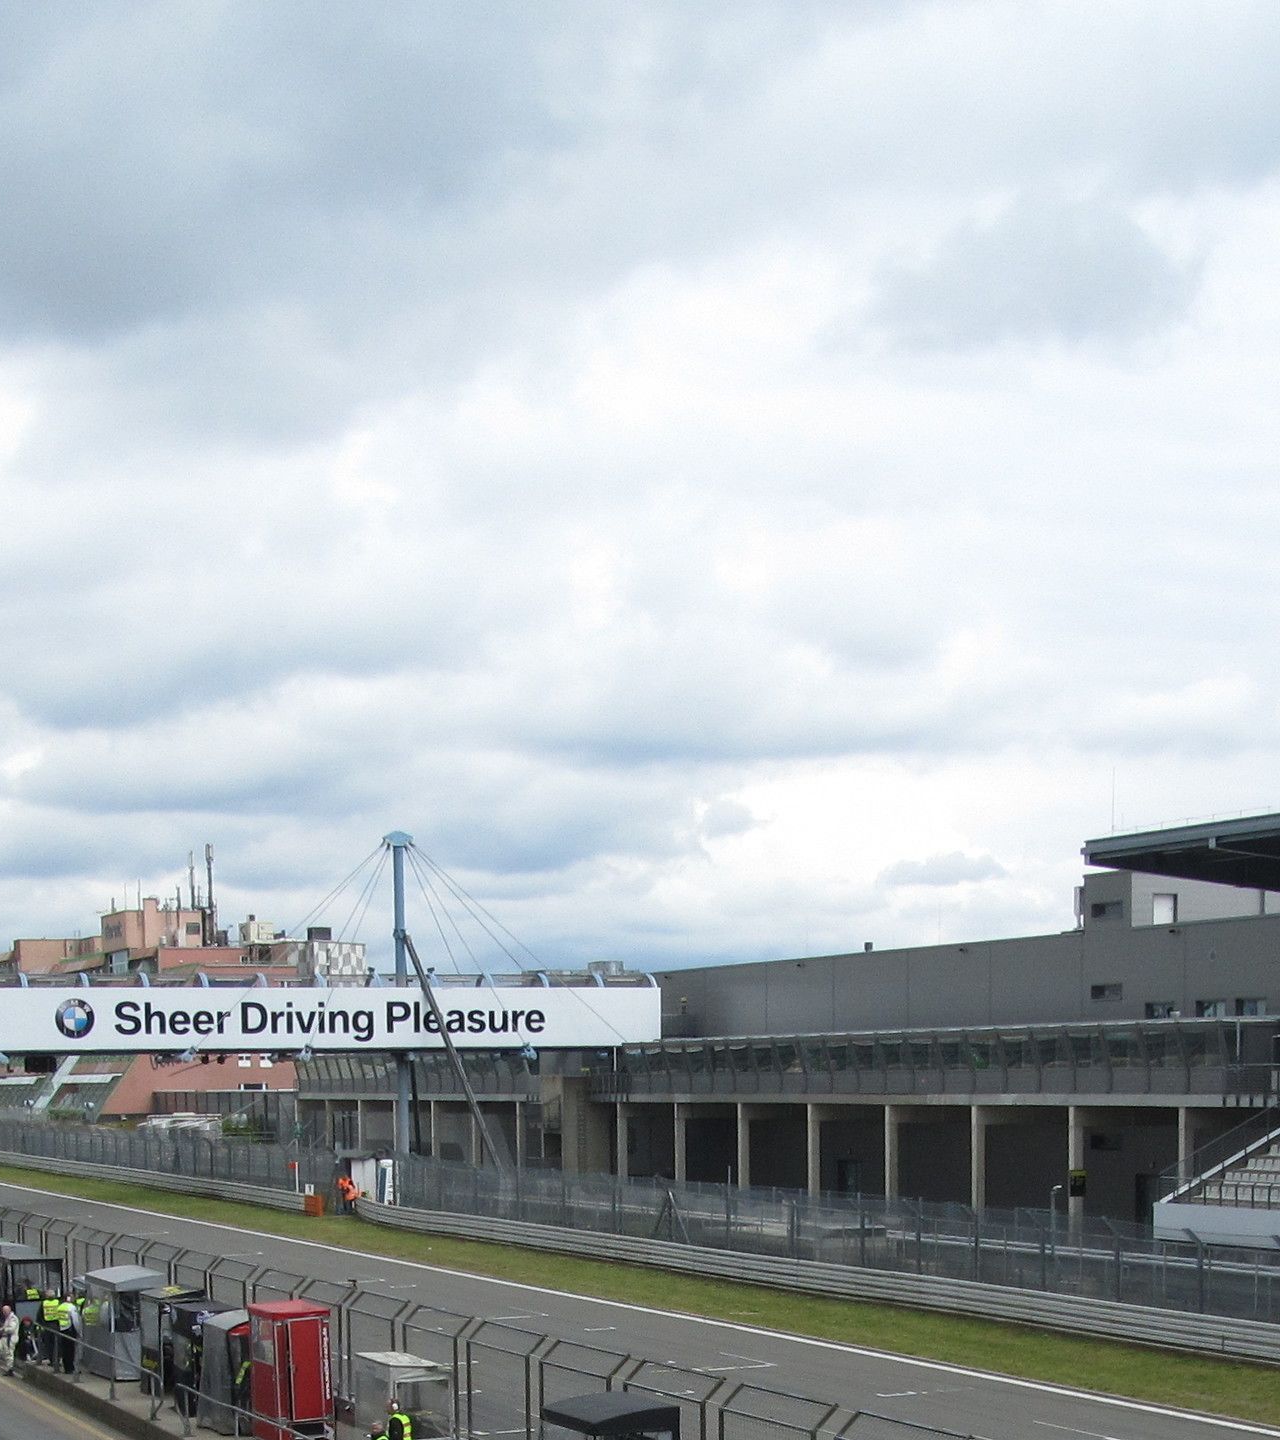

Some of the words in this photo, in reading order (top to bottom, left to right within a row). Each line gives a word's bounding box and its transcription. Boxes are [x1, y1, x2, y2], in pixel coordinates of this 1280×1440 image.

[114, 1001, 231, 1036] Sheer
[241, 1001, 374, 1041] Driving
[386, 1000, 547, 1035] Pleasure
